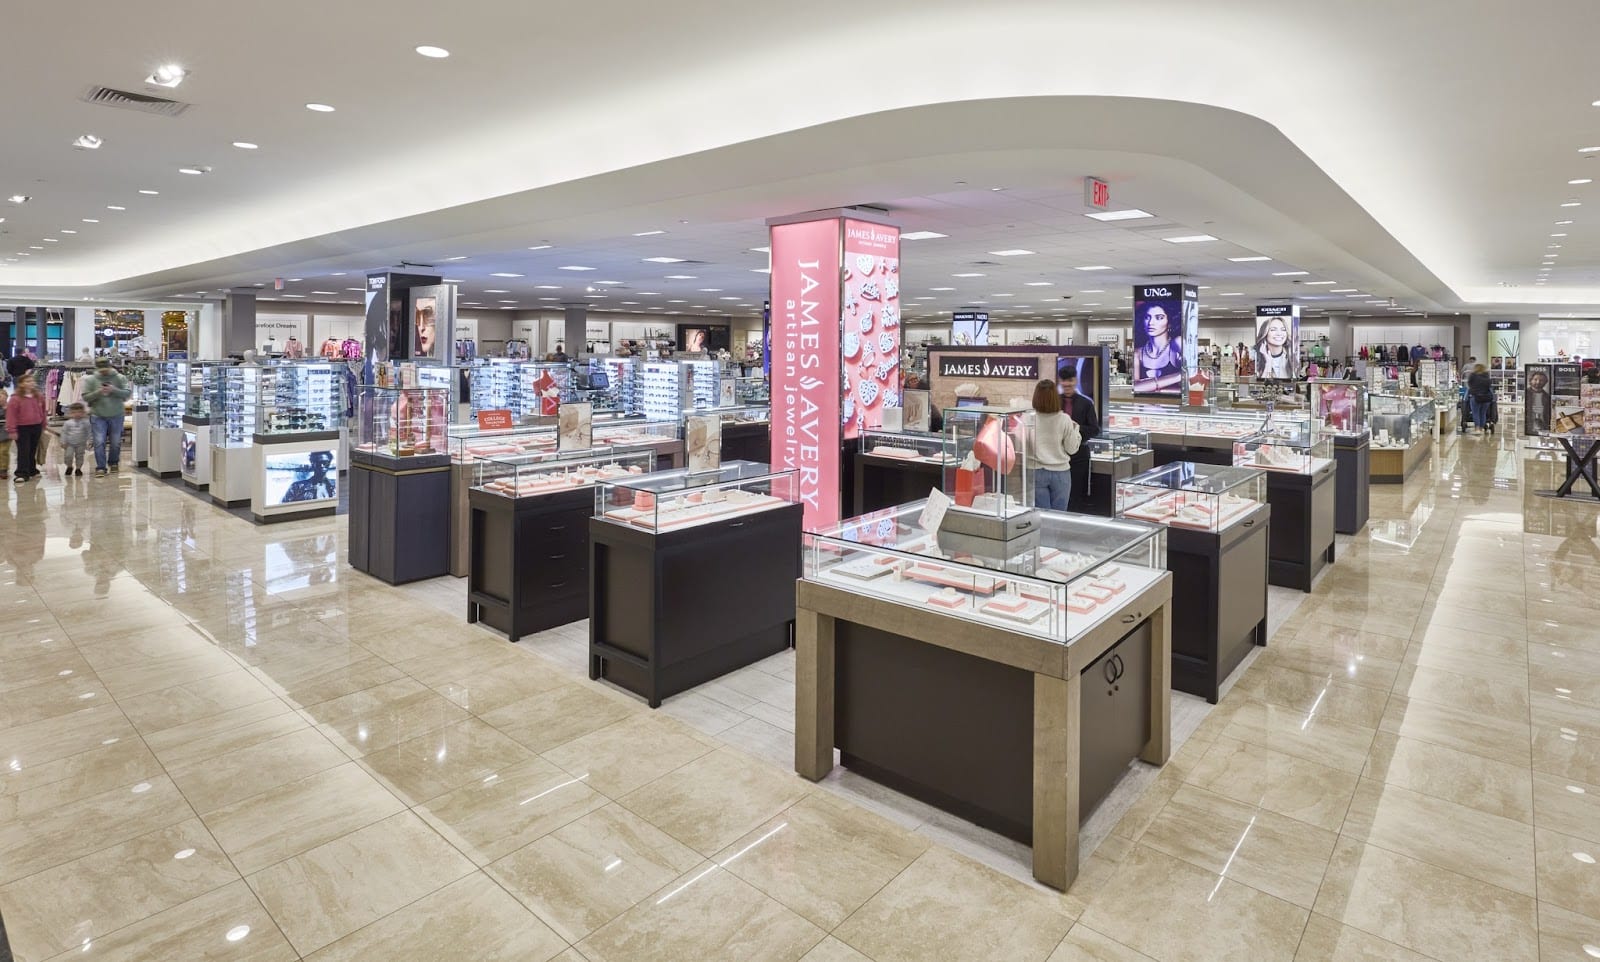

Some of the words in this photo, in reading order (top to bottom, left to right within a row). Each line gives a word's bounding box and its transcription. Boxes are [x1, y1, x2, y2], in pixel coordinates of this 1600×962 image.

[1093, 181, 1107, 206] EXIT
[848, 228, 871, 240] JAMES
[876, 233, 896, 244] AVERY
[786, 299, 798, 377] artisan
[798, 259, 820, 369] JAMES
[944, 364, 981, 376] JAMES
[991, 365, 1032, 377] AVERY
[784, 384, 798, 469] jewelry
[800, 395, 819, 512] AVERY
